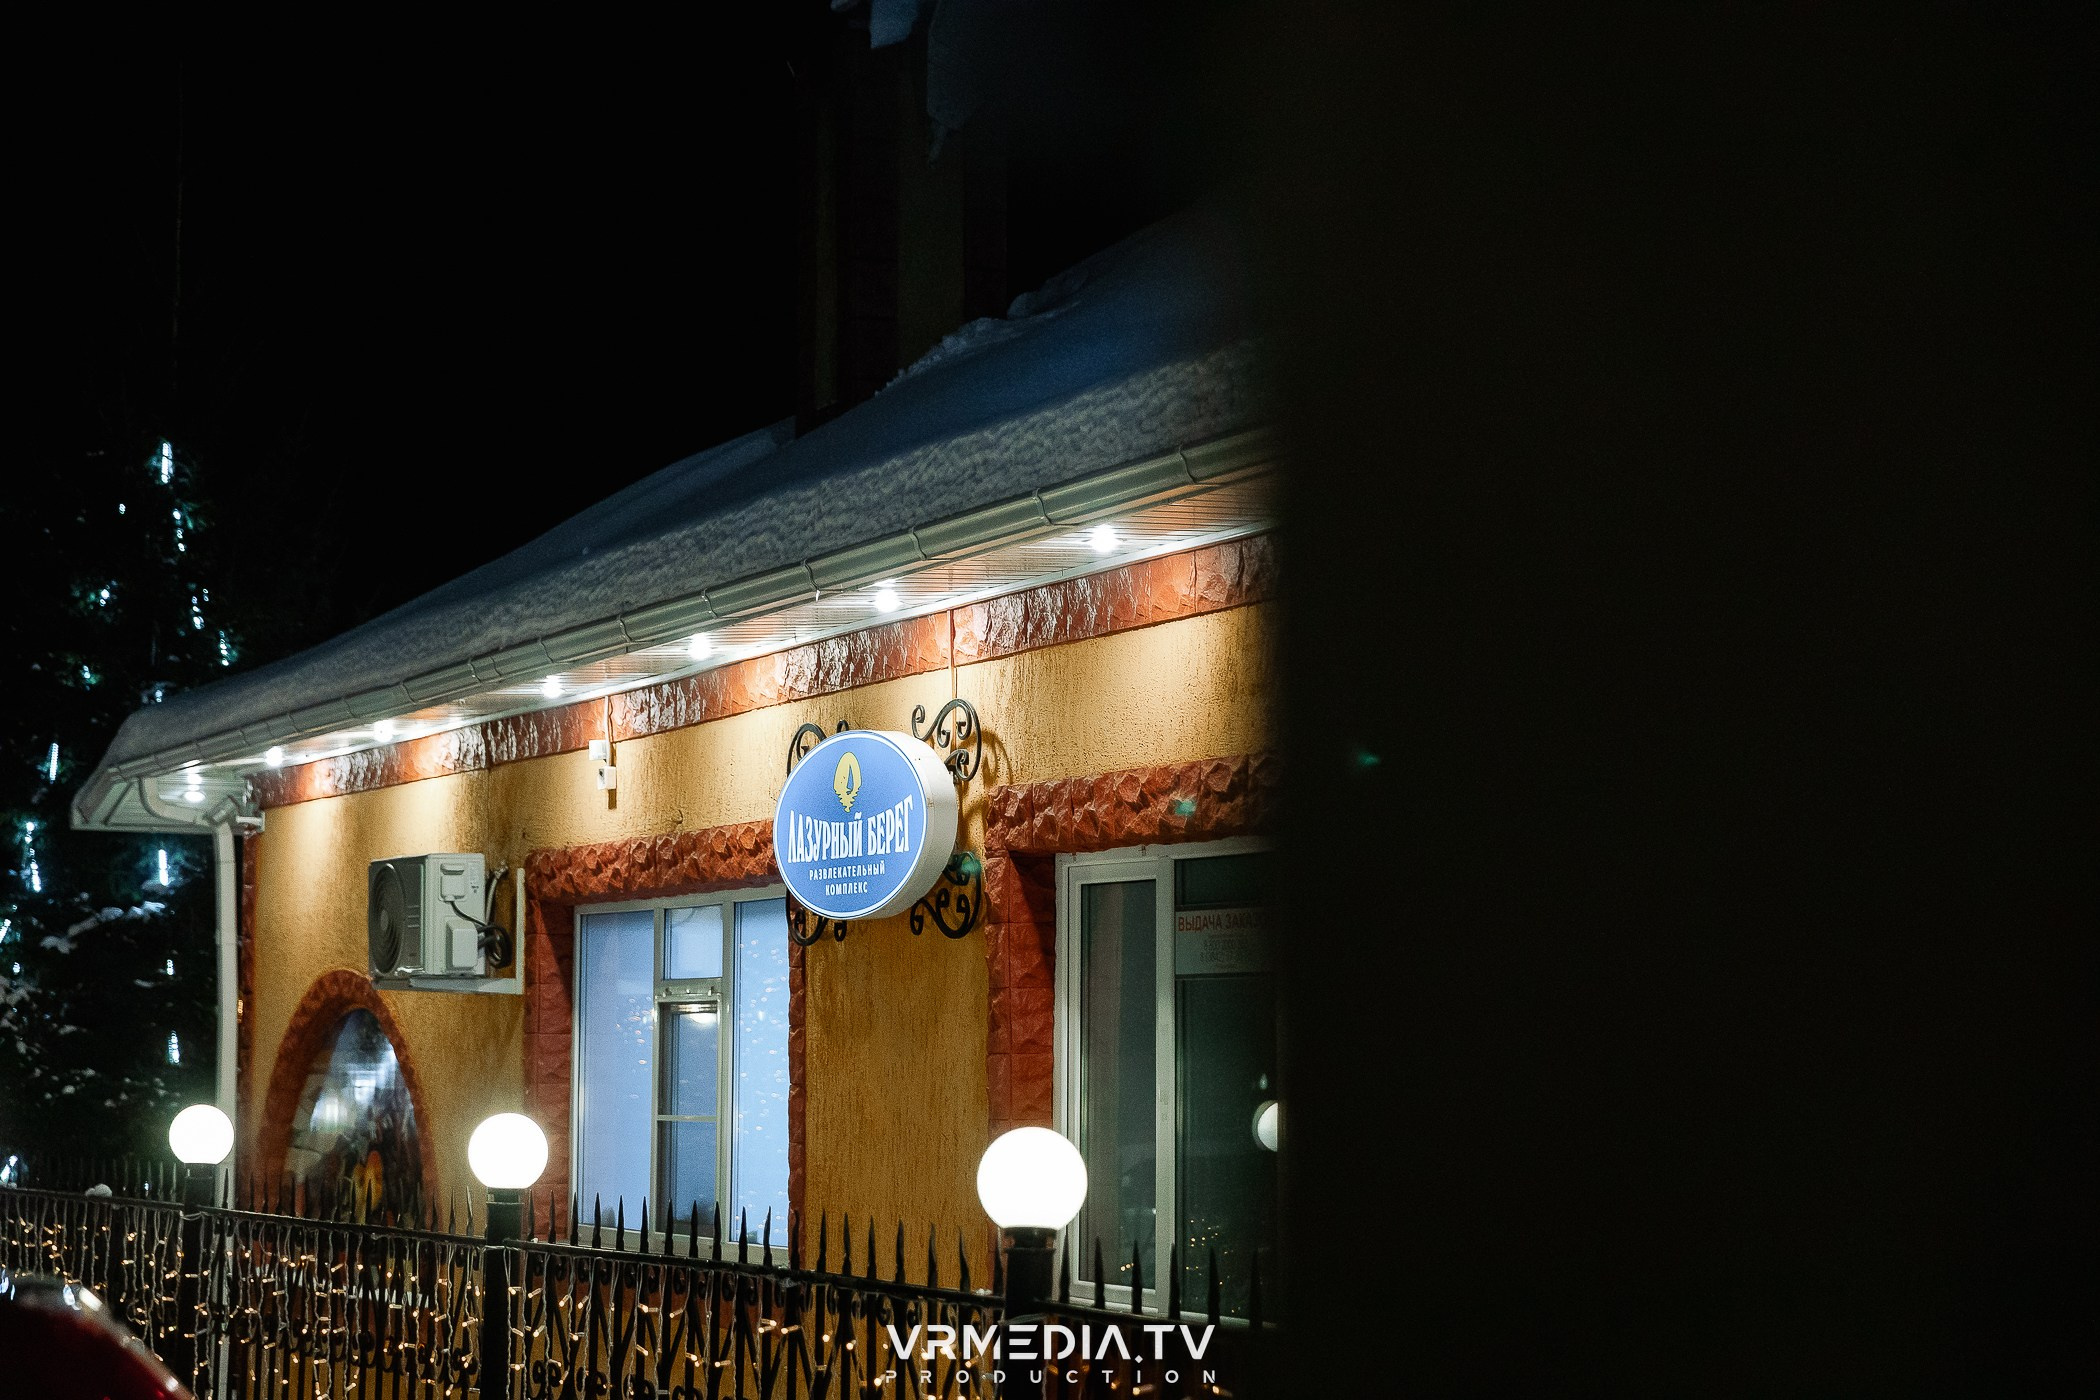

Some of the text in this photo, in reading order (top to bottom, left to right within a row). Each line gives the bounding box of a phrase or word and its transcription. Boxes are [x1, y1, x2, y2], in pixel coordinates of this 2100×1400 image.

[787, 794, 914, 863] ЛАЗУРНЫЙ БЕРЕГ
[809, 860, 885, 880] РАЗВЛЕКАТЕЛЬНЫЙ
[825, 882, 868, 896] КОМПЛЕКС
[1177, 913, 1222, 932] ВЫДАЧА
